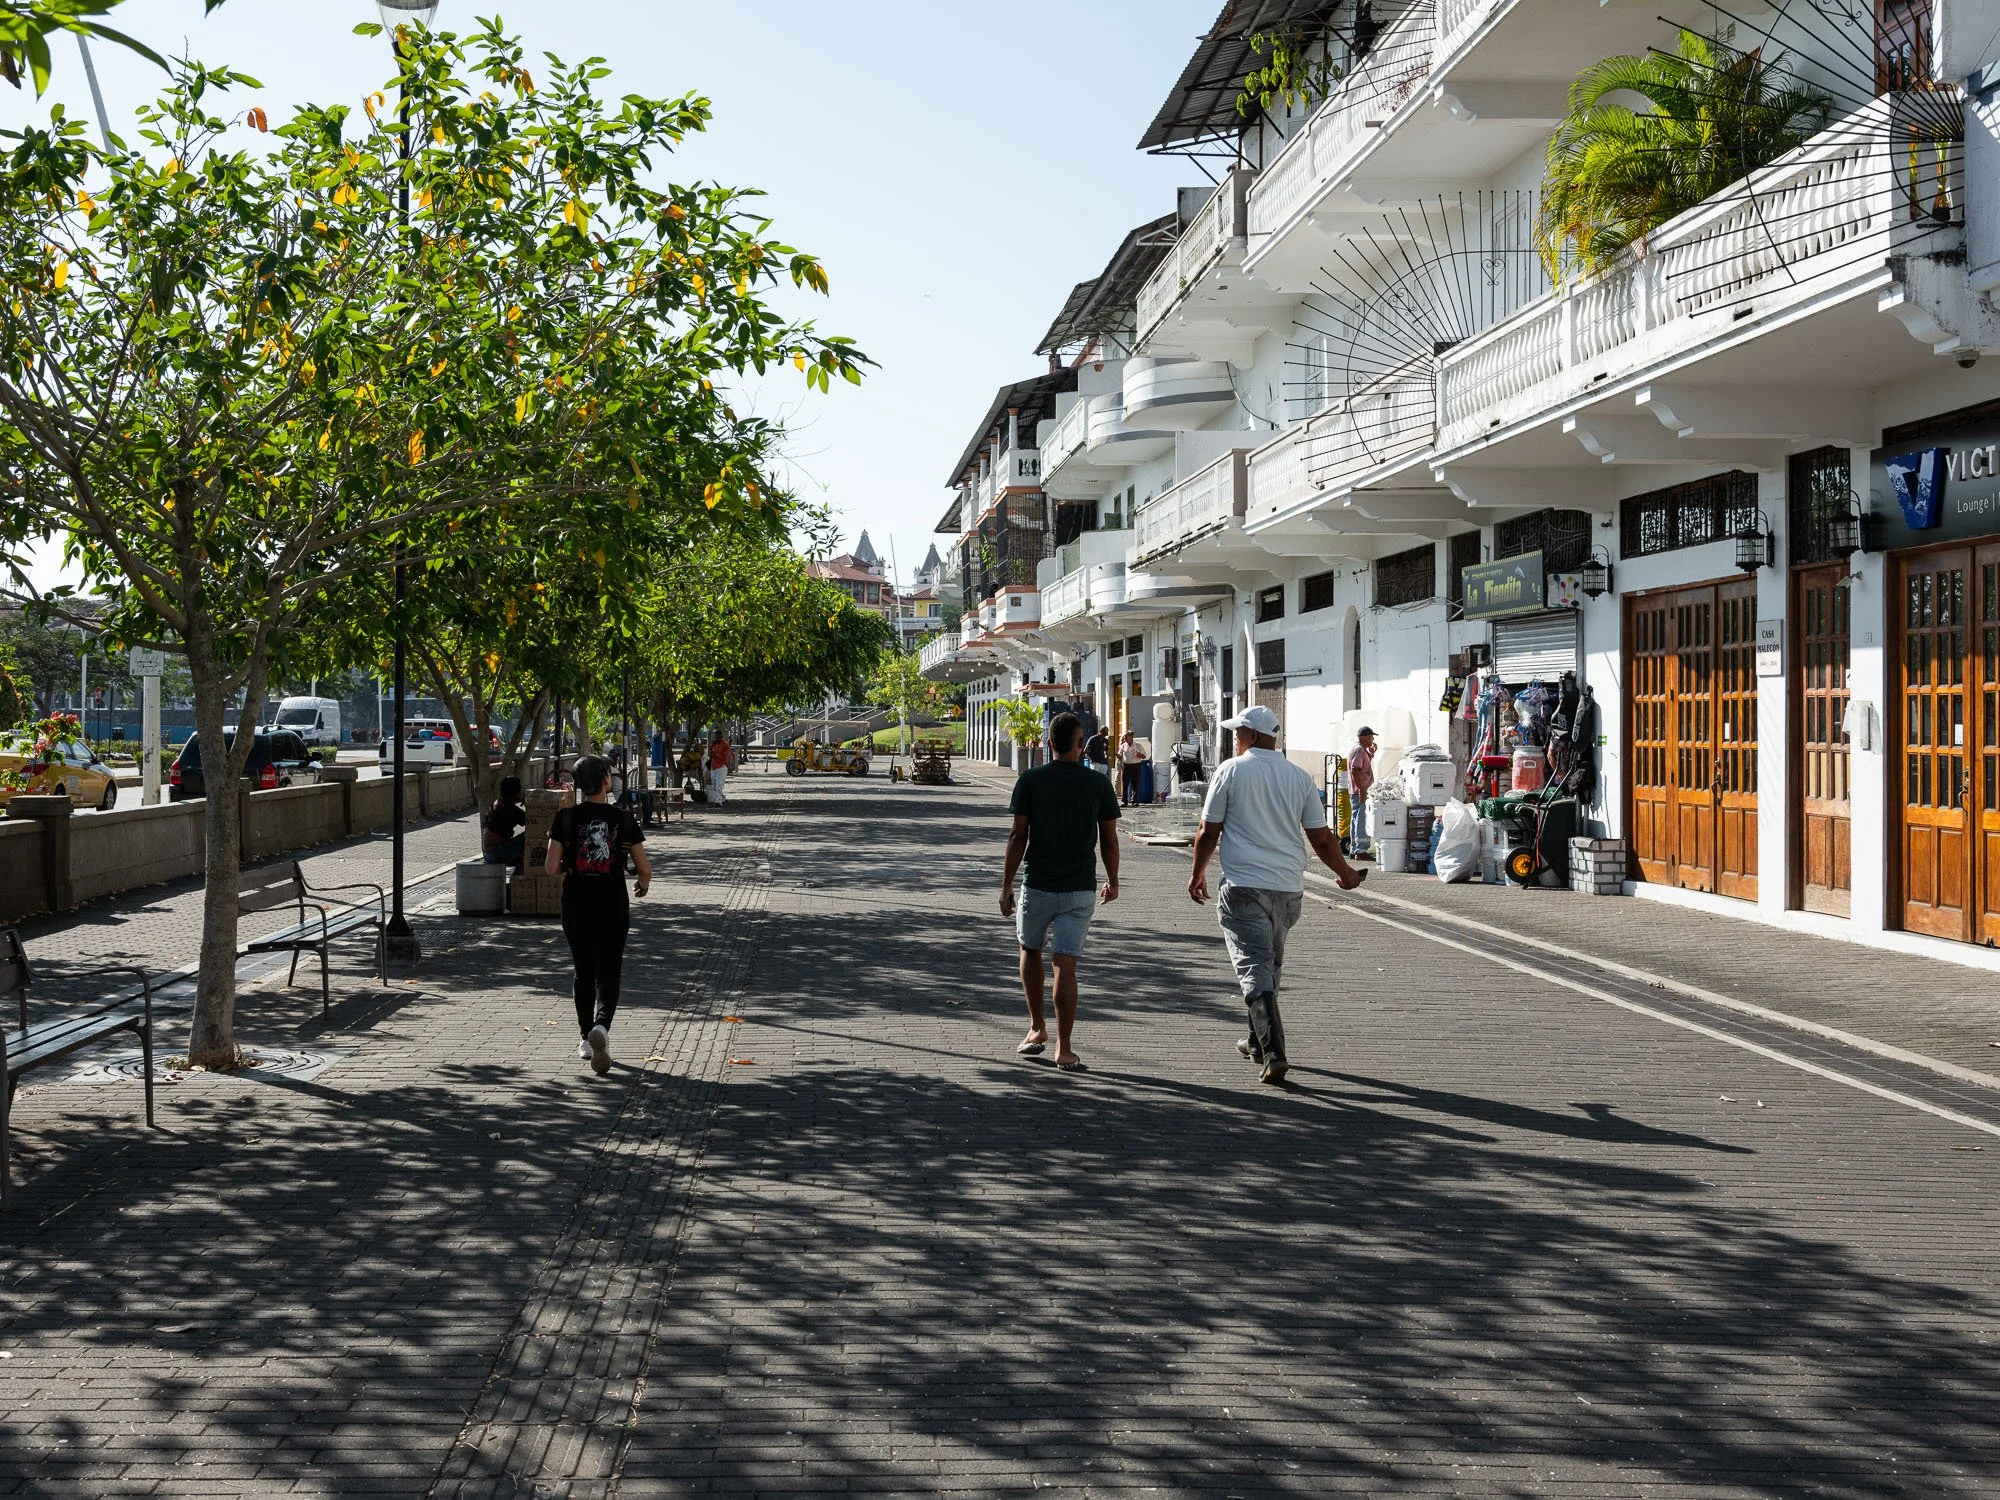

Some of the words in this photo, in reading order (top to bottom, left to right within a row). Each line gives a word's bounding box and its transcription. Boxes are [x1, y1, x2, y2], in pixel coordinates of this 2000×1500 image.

[1957, 498, 1989, 514] Lounge
[1467, 583, 1478, 608] La
[1484, 576, 1522, 605] Tiendita
[1761, 629, 1775, 639] CASA
[1757, 641, 1780, 653] MALECÓN
